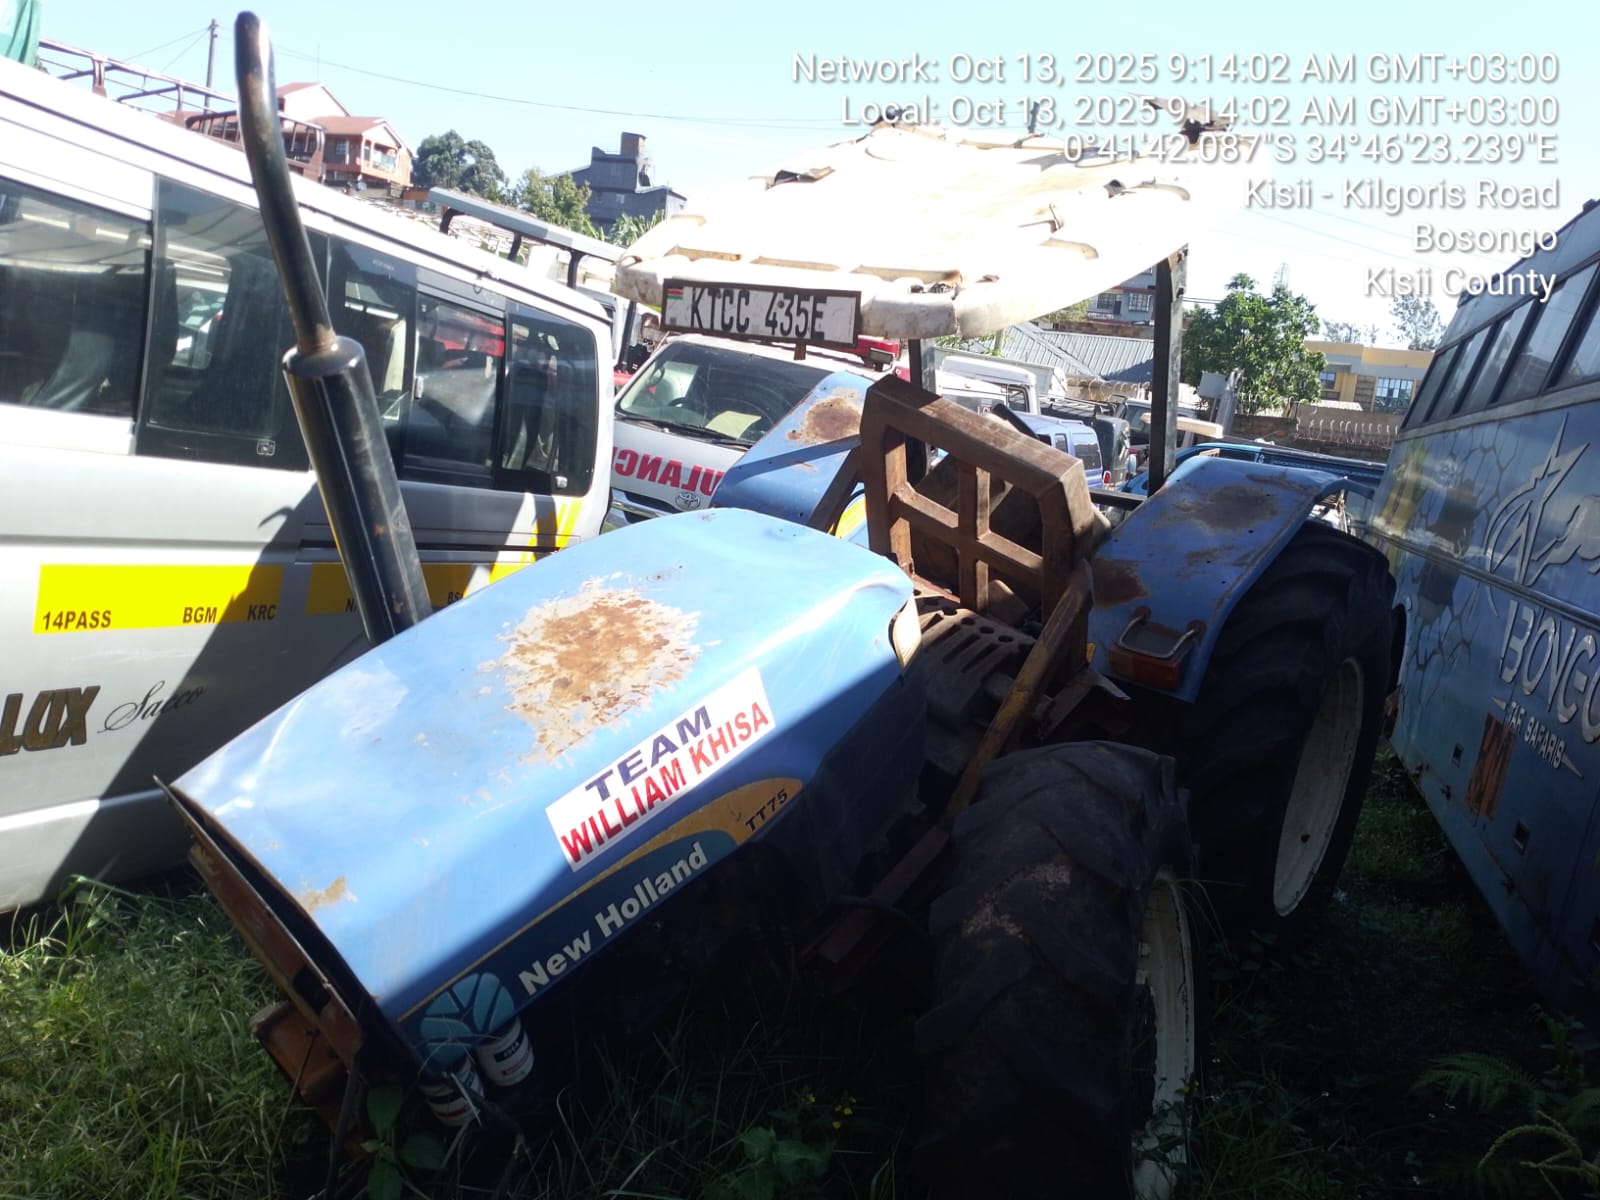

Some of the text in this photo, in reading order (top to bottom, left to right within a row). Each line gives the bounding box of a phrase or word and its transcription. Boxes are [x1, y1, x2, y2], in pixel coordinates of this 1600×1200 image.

[690, 286, 828, 341] KTCC 435E
[42, 610, 112, 631] 14PASS
[182, 606, 218, 624] BGM
[247, 604, 277, 622] KRC
[97, 680, 206, 734] Sacco
[585, 705, 713, 802] TEAM
[561, 702, 769, 864] WILLIAM KHISA
[744, 788, 788, 833] TT75
[518, 842, 708, 997] New Holland
